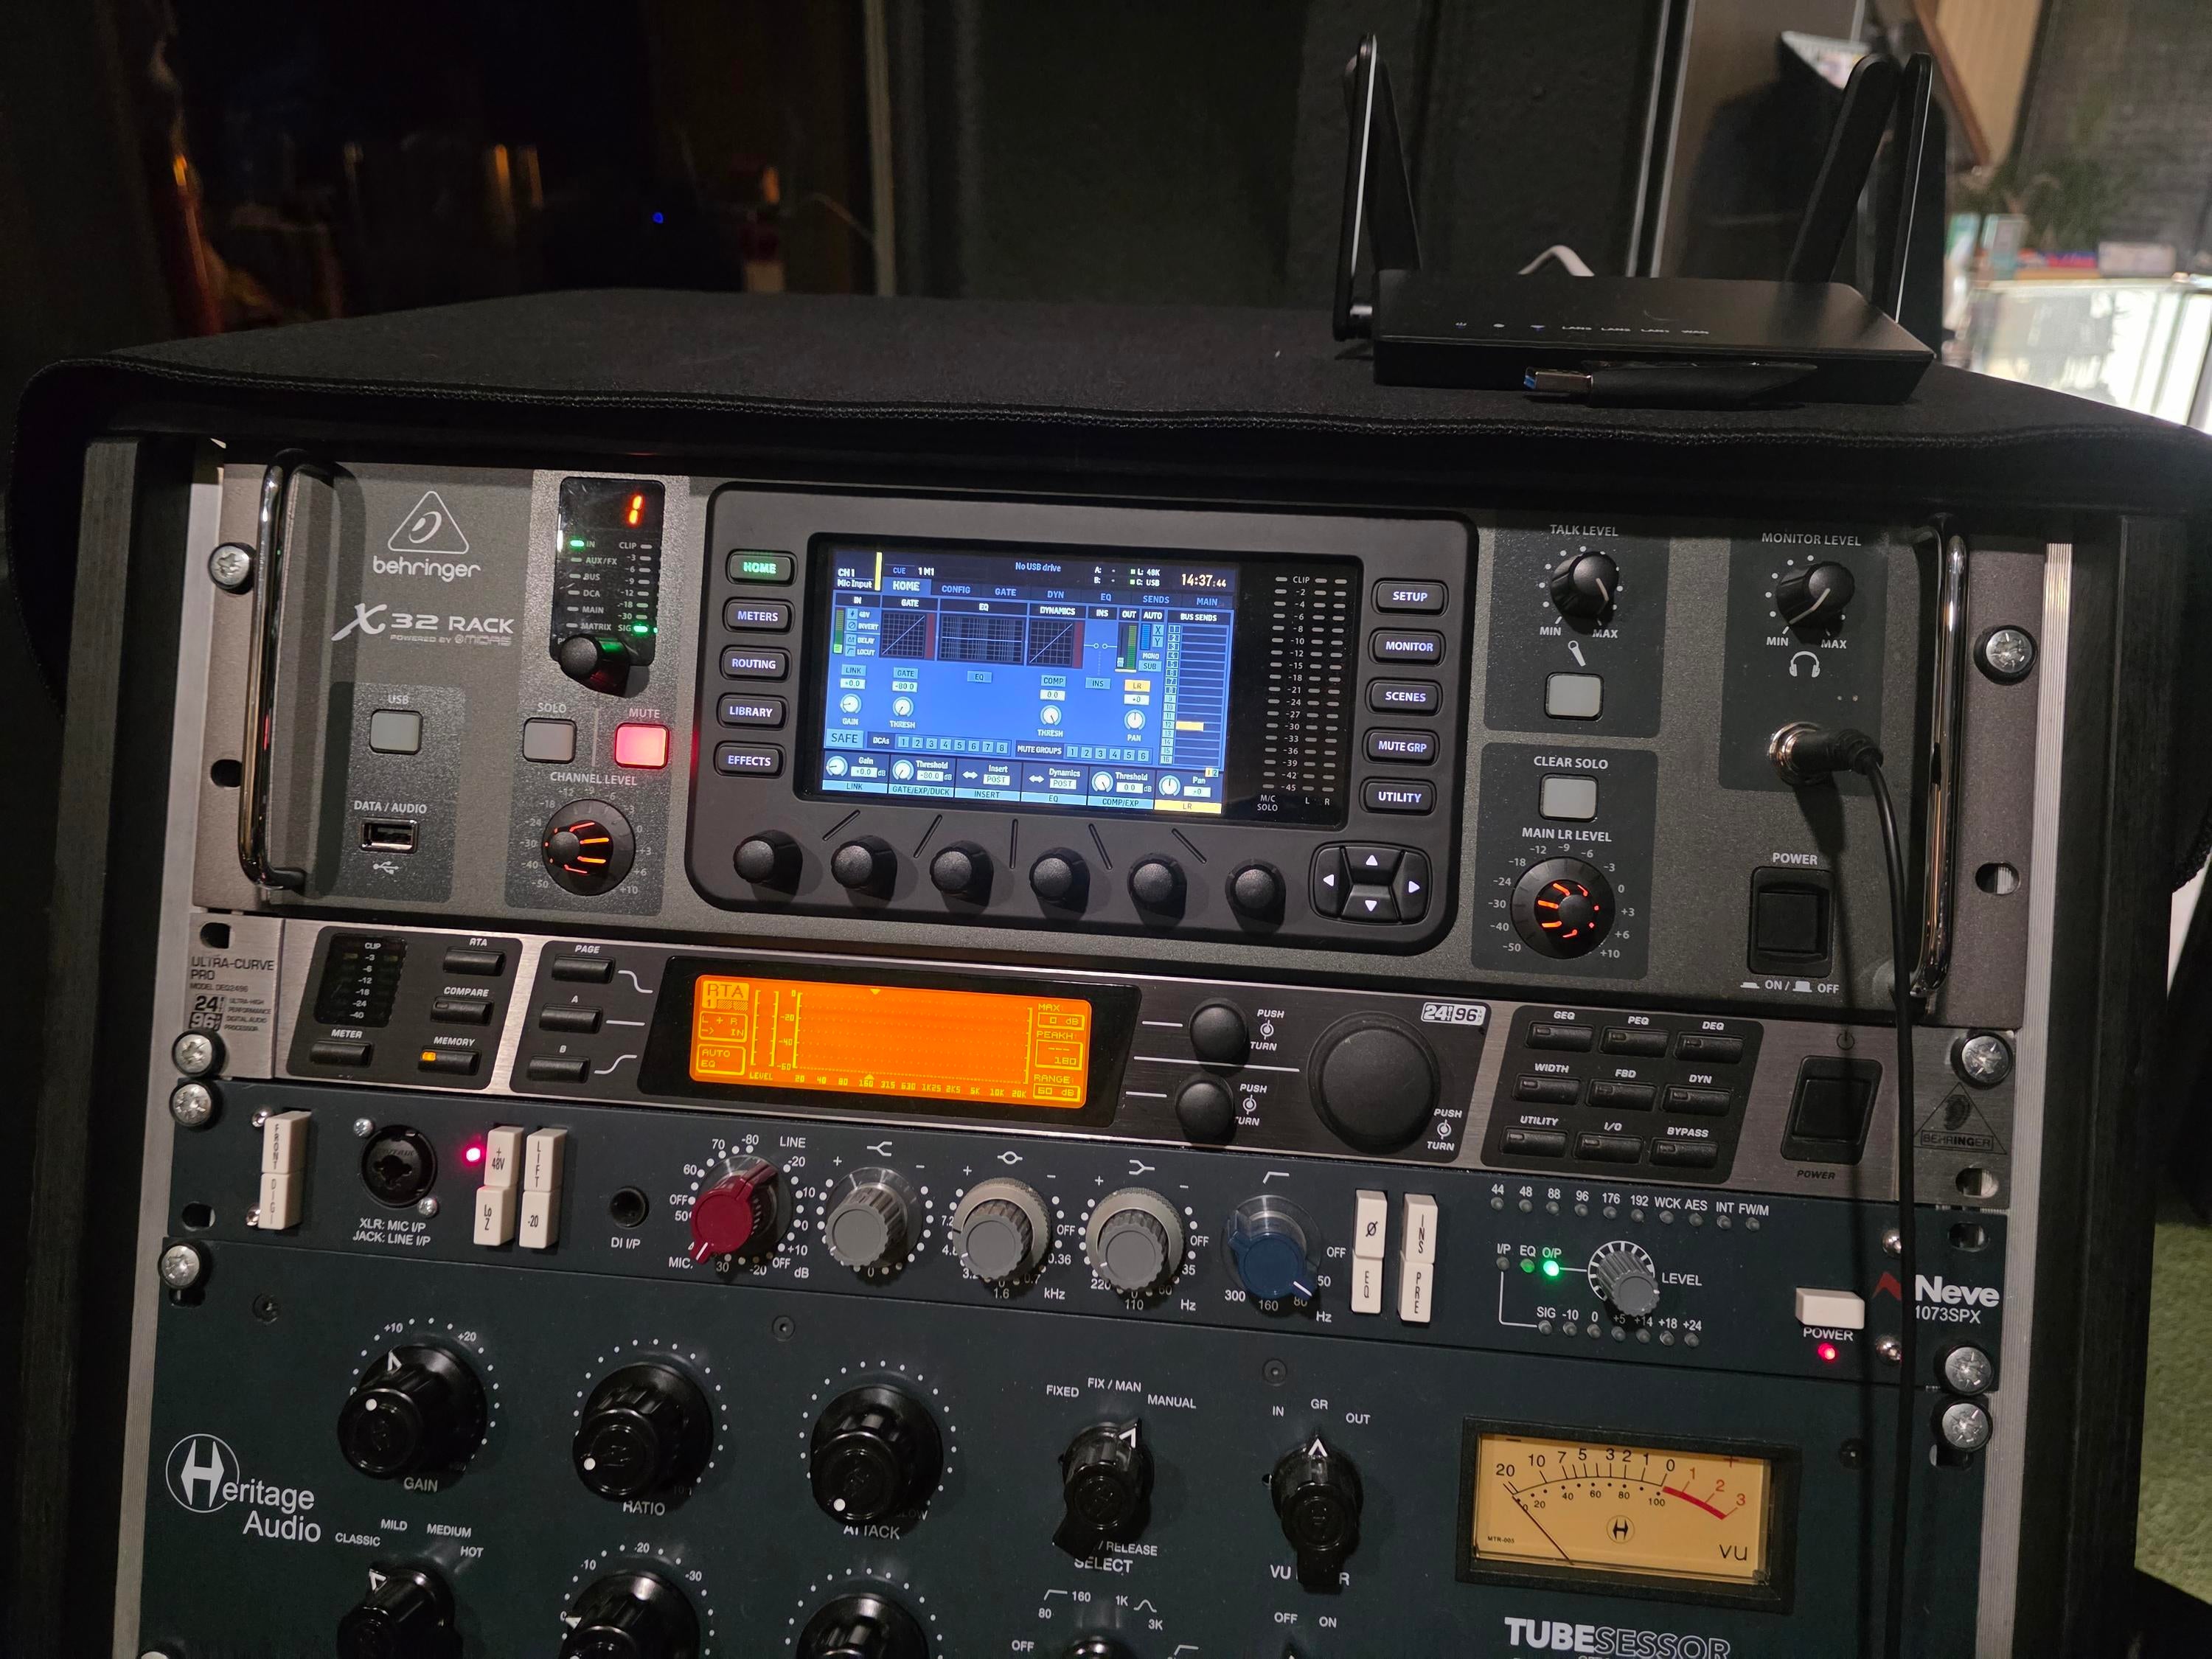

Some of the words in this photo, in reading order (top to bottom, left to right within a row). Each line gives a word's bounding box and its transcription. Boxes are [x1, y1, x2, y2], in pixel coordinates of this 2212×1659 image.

[1550, 524, 1580, 537] TALK
[1583, 526, 1618, 538] LEVEL
[1761, 532, 1822, 546] MONITOR
[1824, 535, 1862, 547] LEVEL
[373, 555, 481, 582] behringer
[743, 561, 776, 574] HOME
[1015, 562, 1025, 570] No
[1026, 563, 1041, 571] USB
[1042, 563, 1060, 571] drive
[892, 581, 920, 591] HOME
[942, 585, 970, 594] CONFIG
[995, 588, 1017, 597] GATE
[1047, 591, 1064, 599] DYN
[1393, 591, 1427, 602] SETUP
[1143, 596, 1169, 604] SENDS
[1197, 598, 1218, 606] MAIN
[737, 611, 779, 622] METERS
[448, 616, 515, 633] RACK
[581, 623, 611, 631] MATRIX
[1540, 626, 1562, 636] MIN
[1593, 628, 1618, 639] MAX
[1386, 641, 1433, 652] MONITOR
[1767, 636, 1789, 647] MIN
[1821, 639, 1847, 649] MAX
[732, 658, 776, 669] ROUTING
[387, 694, 409, 705] USB
[1385, 692, 1426, 702] SCENES
[537, 703, 566, 713] SOLO
[629, 708, 661, 719] MUTE
[729, 706, 773, 717] LIBRARY
[831, 733, 858, 743] SAFE
[1379, 741, 1406, 752] MUTE
[1408, 742, 1427, 753] GRP
[728, 755, 771, 766] EFFECTS
[1534, 756, 1573, 768] CLEAR
[1575, 758, 1608, 770] SOLO
[550, 771, 602, 785] CHANNEL
[605, 775, 637, 786] LEVEL
[893, 786, 950, 796] GATE/EXP/DUCK
[1102, 799, 1139, 807] COMP/EXP
[1260, 794, 1276, 802] M/C
[1378, 792, 1422, 803] UTILITY
[353, 799, 380, 812] DATA
[392, 802, 428, 814] AUDIO
[1256, 804, 1279, 812] SOLO
[1522, 827, 1555, 840] MAIN
[1558, 829, 1573, 841] LR
[1576, 830, 1613, 843] LEVEL
[1772, 853, 1818, 866] POWER
[470, 938, 487, 947] RTA
[575, 945, 600, 954] PAGE
[192, 956, 274, 970] ULTRA-CURVE
[191, 970, 215, 980] PRO
[443, 987, 490, 997] COMPARE
[708, 984, 743, 998] RTA
[1764, 980, 1783, 991] ON
[1817, 982, 1840, 994] OFF
[1257, 1009, 1284, 1019] PUSH
[1554, 1011, 1575, 1020] GEQ
[1628, 1017, 1649, 1026] PEQ
[1703, 1022, 1725, 1031] DEQ
[331, 1029, 363, 1039] METER
[434, 1037, 476, 1046] MEMORY
[1250, 1041, 1277, 1051] TURN
[1534, 1063, 1569, 1074] WIDTH
[1615, 1069, 1637, 1078] FBD
[749, 1072, 773, 1080] LEVEL
[1689, 1074, 1712, 1083] DYN
[1239, 1084, 1267, 1093] PUSH
[1433, 1108, 1463, 1119] PUSH
[1520, 1116, 1559, 1126] UTILITY
[1604, 1122, 1622, 1131] I/O
[1667, 1127, 1709, 1137] BYPASS
[780, 1136, 807, 1149] LINE
[1923, 1133, 1991, 1147] BEHRINGER
[1427, 1141, 1455, 1151] TURN
[492, 1158, 505, 1170] 48V
[1796, 1170, 1835, 1180] POWER
[1655, 1197, 1681, 1209] WCK
[1684, 1198, 1708, 1211] AES
[1716, 1201, 1734, 1212] INT
[1739, 1203, 1770, 1216] FW/M
[359, 1218, 384, 1229] XLR:
[388, 1220, 409, 1231] MIC
[411, 1222, 426, 1233] I/P
[353, 1231, 384, 1242] JACK:
[388, 1232, 414, 1245] LINE
[416, 1234, 431, 1247] I/P
[611, 1237, 622, 1248] DI
[626, 1239, 641, 1250] I/P
[1326, 1247, 1346, 1258] OFF
[1497, 1243, 1511, 1254] I/P
[1520, 1245, 1536, 1257] EQ
[1542, 1246, 1562, 1259] O/P
[1662, 1272, 1703, 1286] LEVEL
[1044, 1287, 1065, 1300] kHz
[1915, 1274, 2000, 1307] Neve
[1180, 1298, 1196, 1312] Hz
[1317, 1311, 1332, 1322] Hz
[1537, 1306, 1556, 1318] SIG
[1915, 1305, 1981, 1324] 1073SPX
[1803, 1327, 1854, 1341] POWER
[1088, 1377, 1105, 1390] FIX
[1115, 1380, 1141, 1393] MAN
[1046, 1385, 1079, 1398] FIXED
[1147, 1394, 1197, 1410] MANUAL
[1310, 1399, 1329, 1411] GR
[1272, 1405, 1284, 1417] IN
[1346, 1413, 1371, 1425] OUT
[403, 1476, 439, 1493] GAIN
[622, 1500, 665, 1516] RATIO
[243, 1510, 321, 1543] Audio
[380, 1518, 408, 1531] MILD
[427, 1523, 472, 1538] MEDIUM
[335, 1532, 380, 1547] CLASSIC
[460, 1545, 484, 1558] HOT
[1719, 1543, 1748, 1562] VU
[1274, 1612, 1298, 1625] OFF
[1319, 1616, 1337, 1628] ON
[1504, 1616, 1731, 1659] TUBESESSOR
